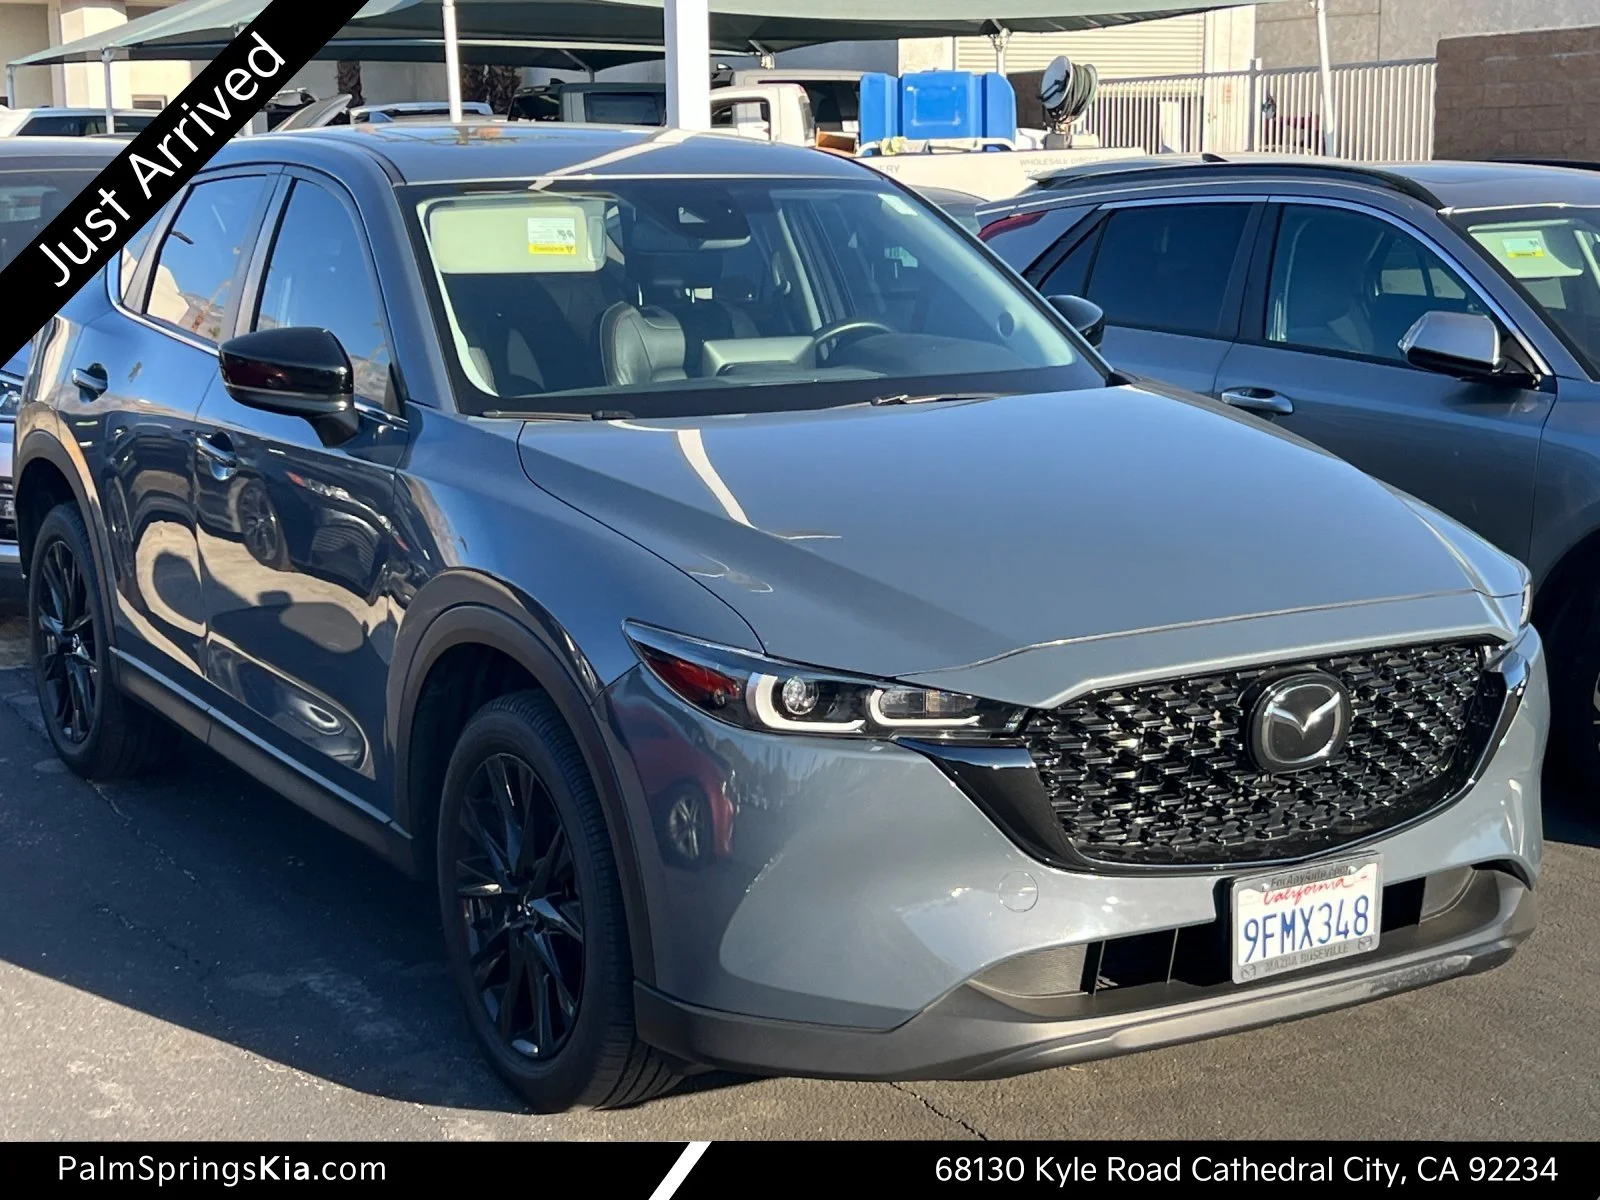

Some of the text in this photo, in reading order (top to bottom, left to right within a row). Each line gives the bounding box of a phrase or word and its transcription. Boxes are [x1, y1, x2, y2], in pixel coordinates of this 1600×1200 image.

[1263, 876, 1354, 906] California
[1243, 894, 1370, 963] 9FMX348
[1264, 955, 1298, 973] MAZDA
